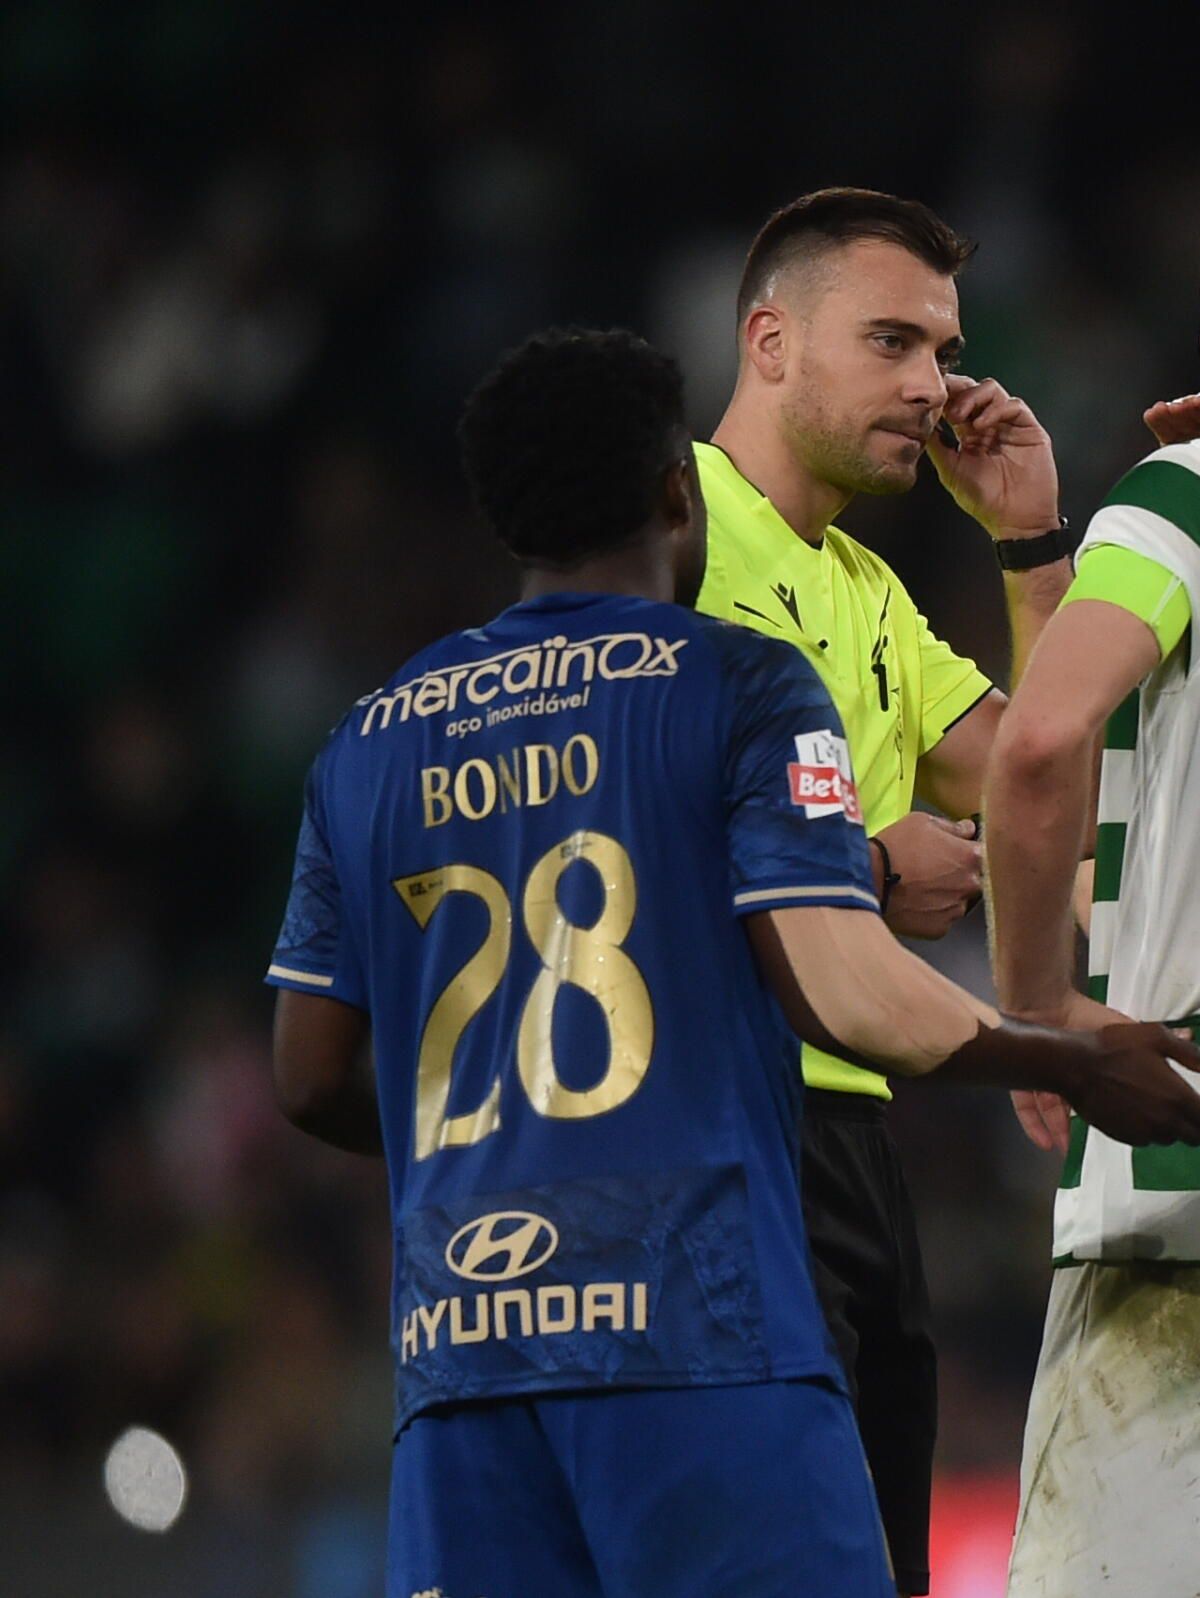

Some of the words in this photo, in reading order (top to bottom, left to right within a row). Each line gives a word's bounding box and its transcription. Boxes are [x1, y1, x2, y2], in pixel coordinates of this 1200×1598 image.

[446, 715, 482, 738] aço
[486, 686, 591, 728] inoxidável
[421, 734, 599, 828] BONDO
[391, 830, 654, 1162] 28
[401, 1282, 647, 1365] HYUNDAI
